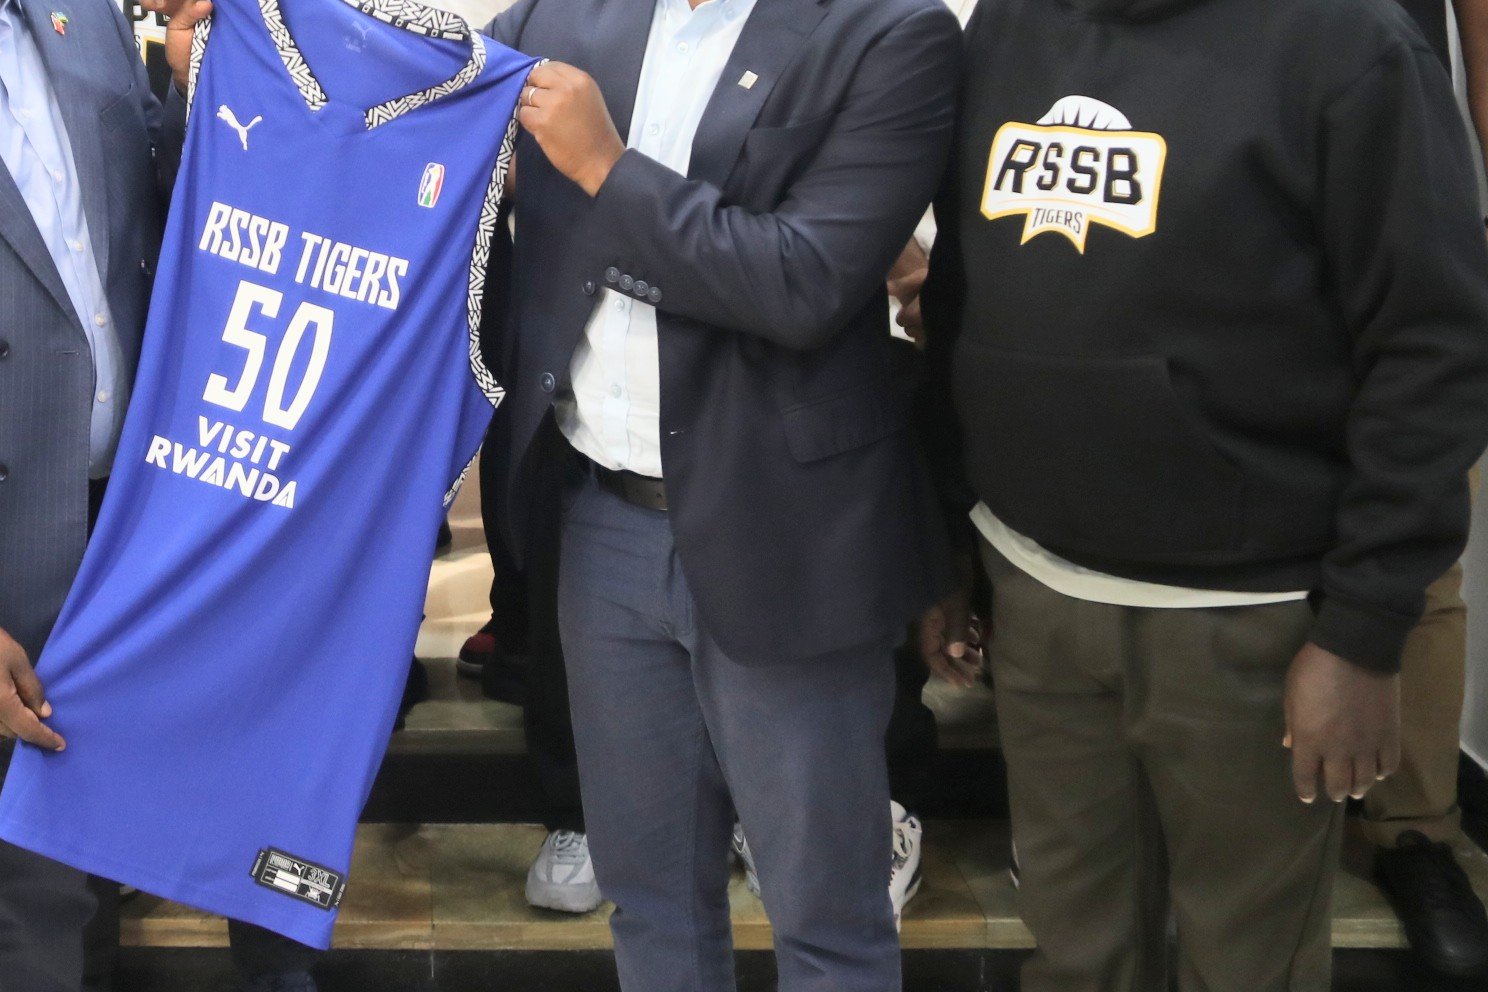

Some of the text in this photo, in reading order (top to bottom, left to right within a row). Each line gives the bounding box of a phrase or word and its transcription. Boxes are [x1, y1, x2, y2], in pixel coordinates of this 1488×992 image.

[993, 138, 1143, 206] RSSB
[198, 201, 410, 311] RSSB TIGERS
[1031, 207, 1083, 235] TIGERS
[202, 279, 335, 431] 50
[145, 434, 298, 509] RWANDA
[198, 415, 291, 471] VISIT
